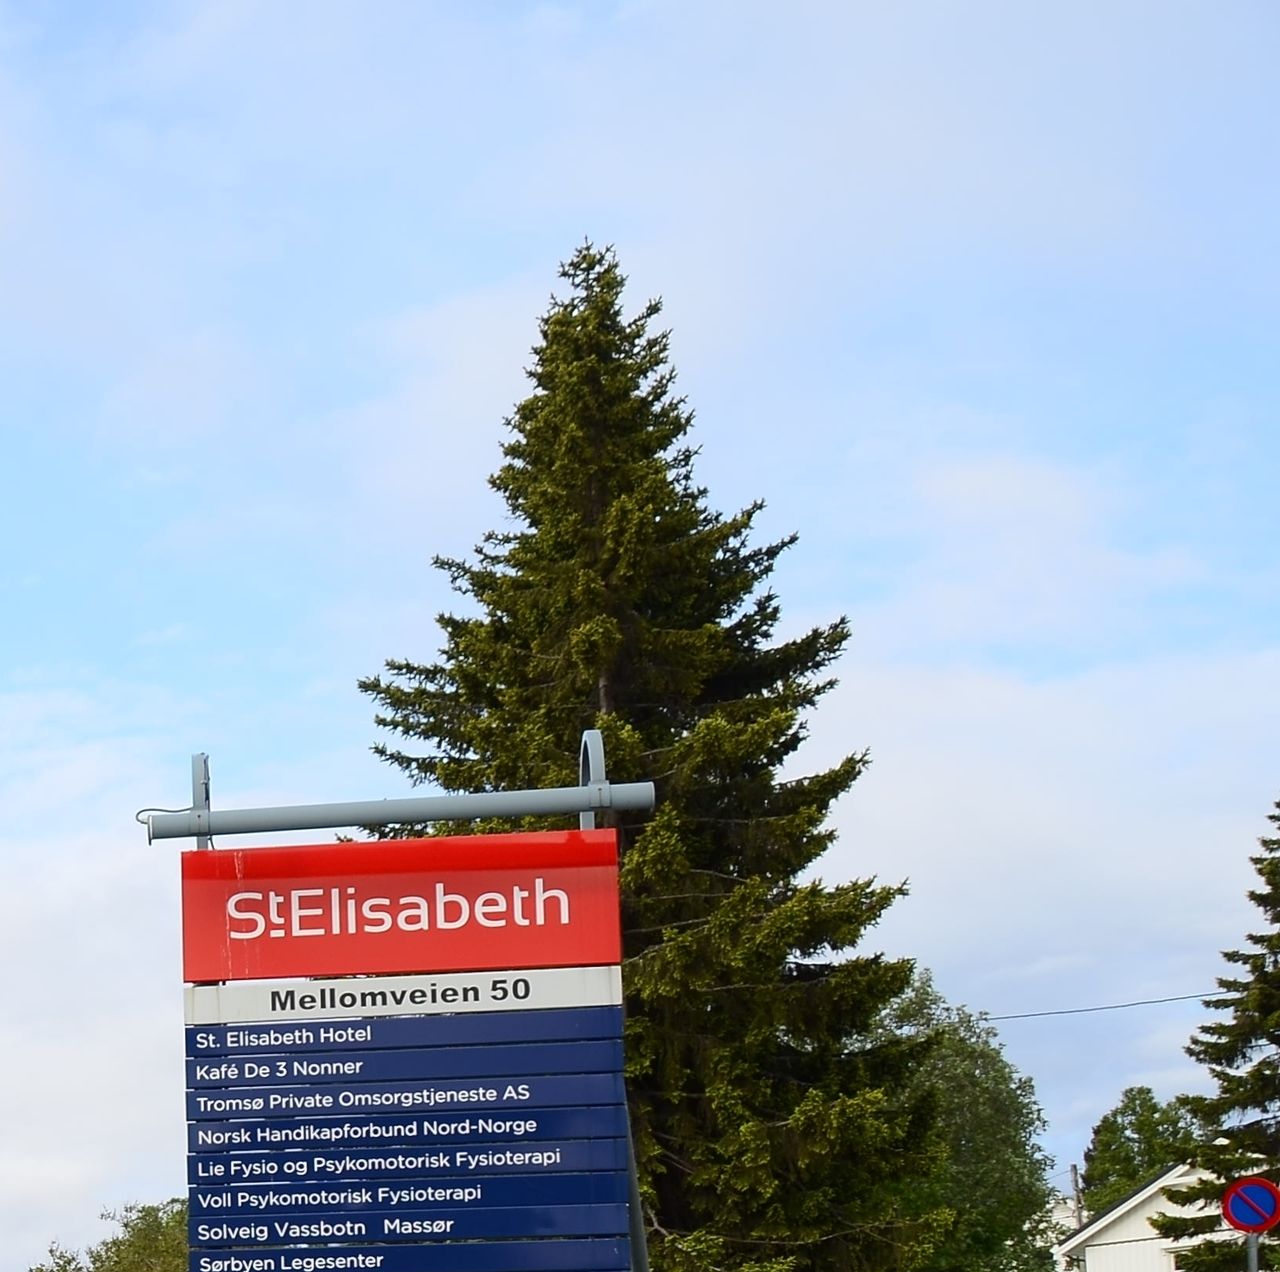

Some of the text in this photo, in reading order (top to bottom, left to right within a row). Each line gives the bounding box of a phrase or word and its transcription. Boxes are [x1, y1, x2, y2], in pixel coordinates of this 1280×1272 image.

[227, 879, 569, 939] St.Elisabeth
[272, 979, 529, 1011] Mellomveien 50
[197, 1025, 371, 1048] St. Elisabeth Hotel
[197, 1061, 363, 1080] Kafé De 3 Nonner
[196, 1085, 529, 1111] Tromsø Private Omsorgstjeneste AS
[199, 1119, 536, 1144] Norsk Handikapforbund Nord-Norge
[199, 1149, 560, 1177] Lie Fysio og Psykomotorisk Fysioterapi
[198, 1185, 481, 1208] Voll Psykomotorisk Fysioterapi
[198, 1219, 454, 1240] Solveig Vassbotn Massør
[200, 1254, 383, 1272] Sørbyen Legesenter
